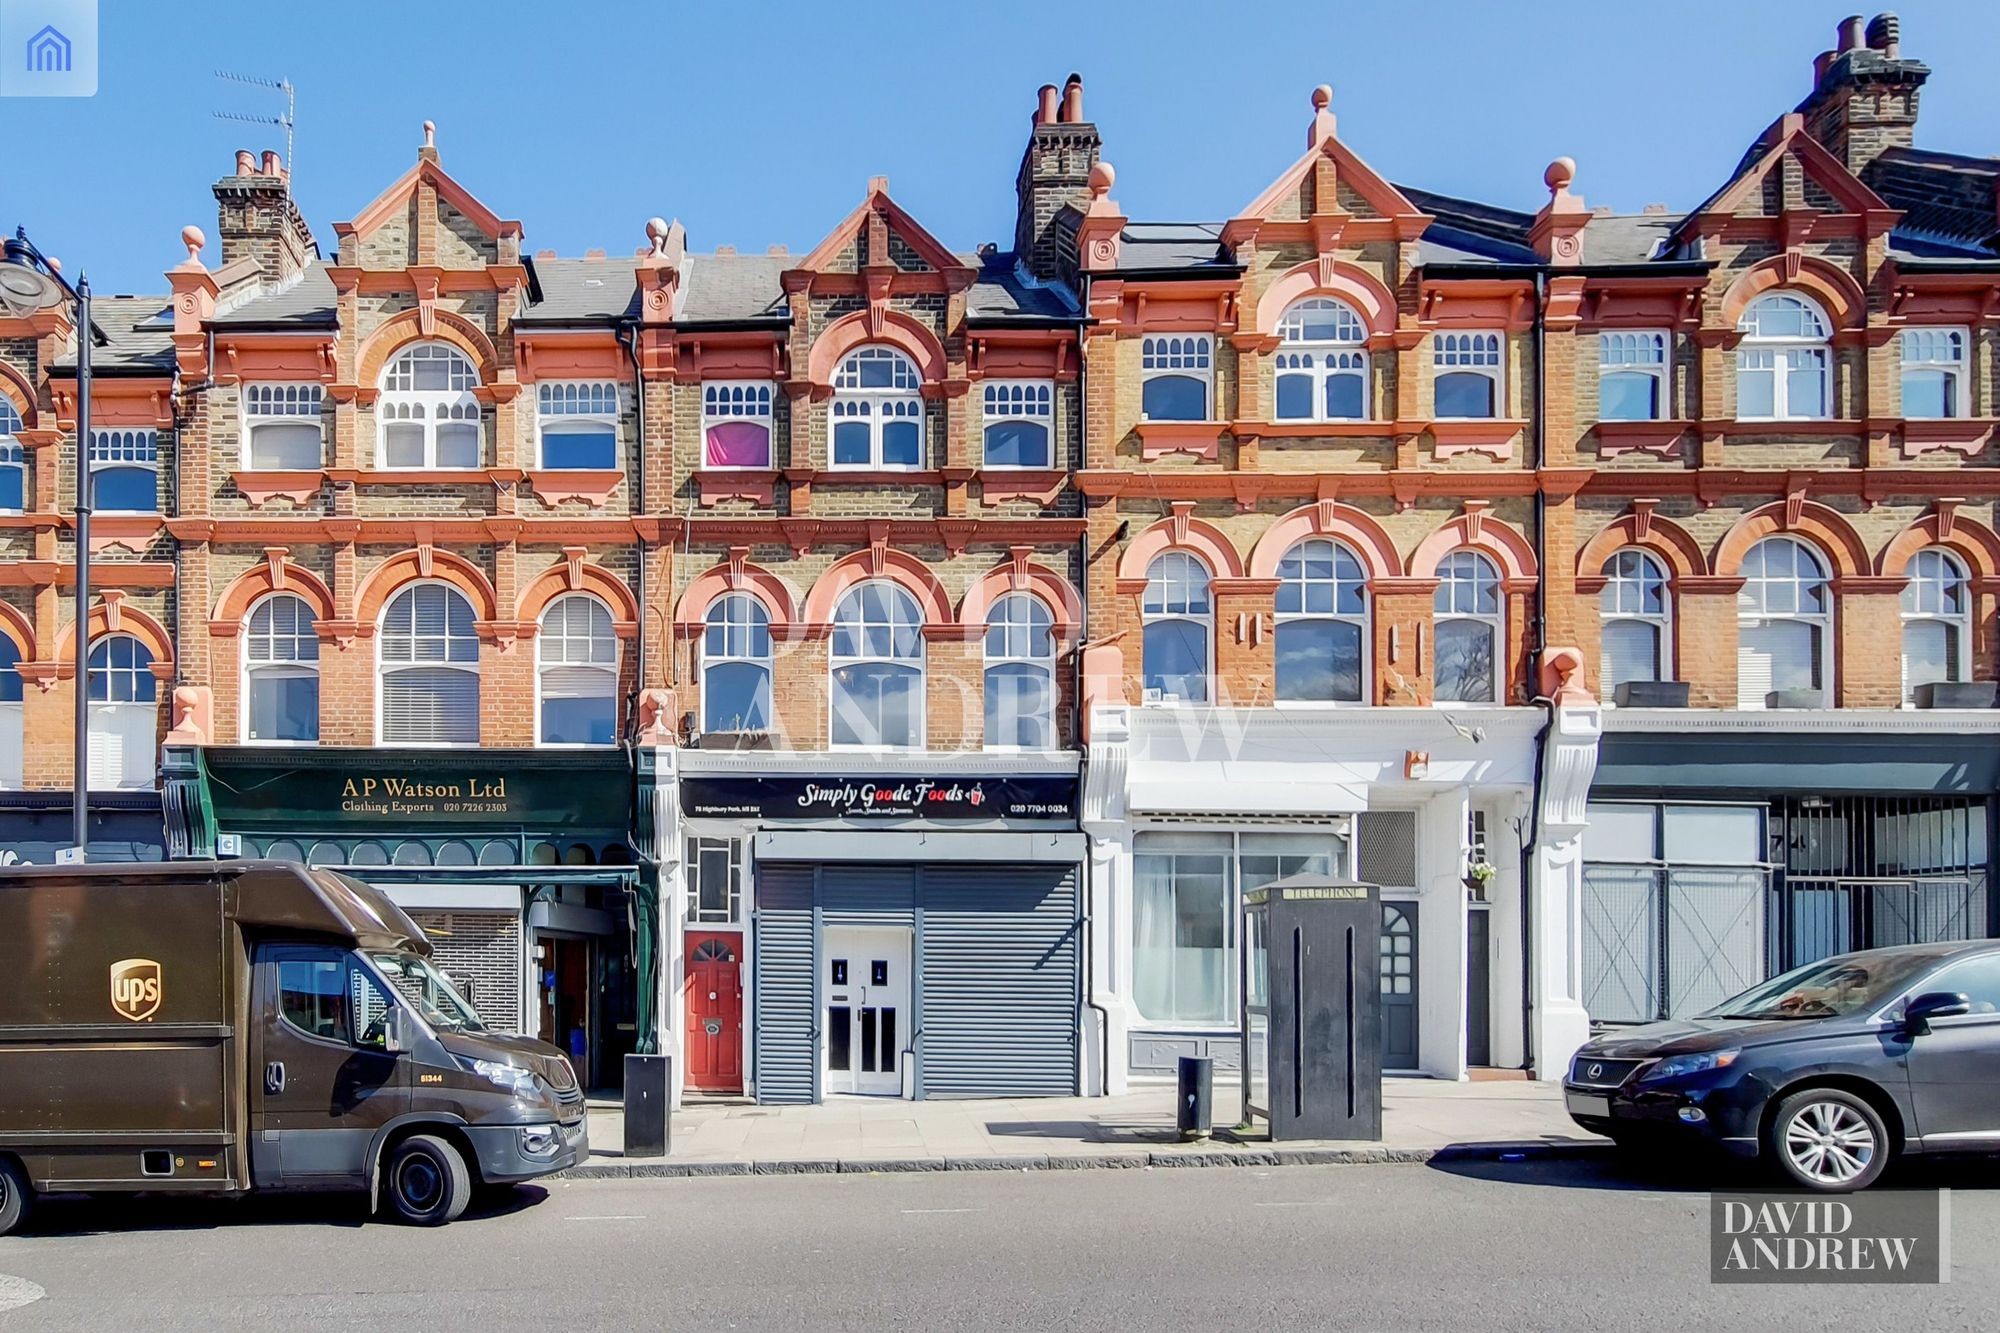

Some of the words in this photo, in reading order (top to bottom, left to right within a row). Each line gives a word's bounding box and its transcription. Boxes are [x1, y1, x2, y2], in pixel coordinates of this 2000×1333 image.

[382, 778, 461, 797] Watson
[468, 778, 506, 797] Ltd
[797, 783, 858, 807] Simply
[860, 783, 911, 807] Goode
[913, 781, 964, 806] Foods
[342, 801, 388, 814] Clothing
[392, 801, 434, 814] Exports
[443, 802, 460, 812] 020
[462, 802, 484, 812] 7226
[485, 802, 507, 812] 2303
[1010, 804, 1026, 813] 020
[1027, 804, 1046, 813] 7704
[1047, 804, 1068, 813] 0034
[115, 978, 157, 1012] ups
